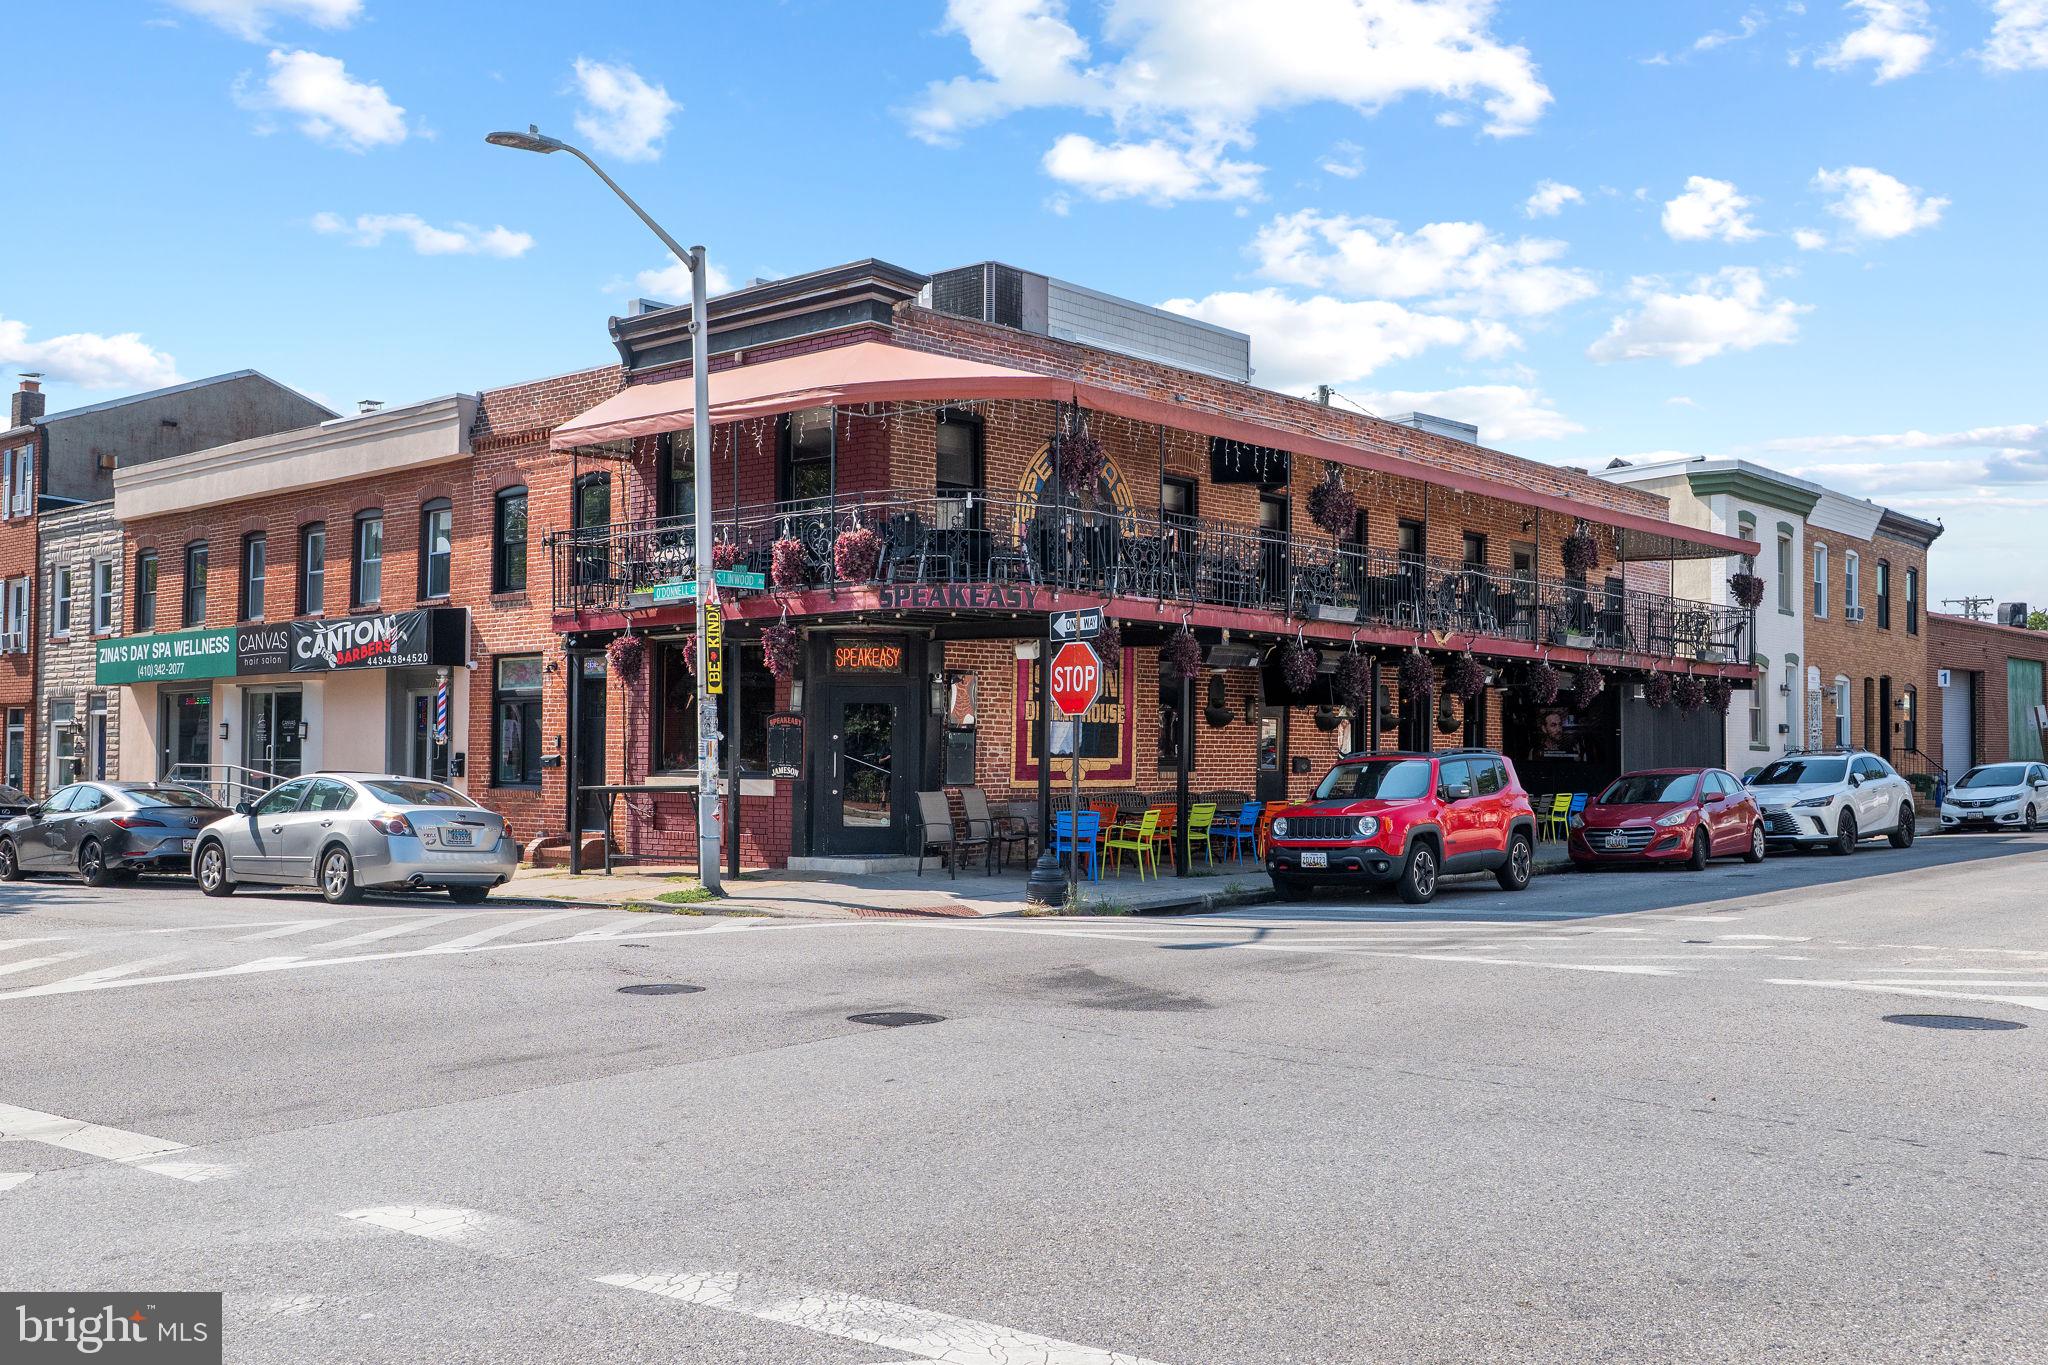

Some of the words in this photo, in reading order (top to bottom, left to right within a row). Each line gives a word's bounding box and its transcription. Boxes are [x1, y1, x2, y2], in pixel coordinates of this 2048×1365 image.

[879, 584, 1041, 609] SPEAKEASY
[1065, 618, 1078, 631] ON
[1083, 616, 1097, 629] WAY
[238, 631, 288, 652] CANVAS
[297, 617, 390, 659] CANTON
[99, 645, 128, 664] ZINA'S
[130, 643, 149, 661] DAY
[152, 641, 172, 659] SPA
[173, 635, 230, 657] WELLNESS
[336, 640, 391, 665] BARBERS
[835, 647, 900, 667] SPEAKEASY
[244, 656, 259, 666] hair
[261, 655, 282, 665] salon
[709, 661, 720, 682] BE
[1053, 665, 1095, 693] STOP
[1941, 673, 1948, 685] 1
[772, 766, 800, 778] JAMESON
